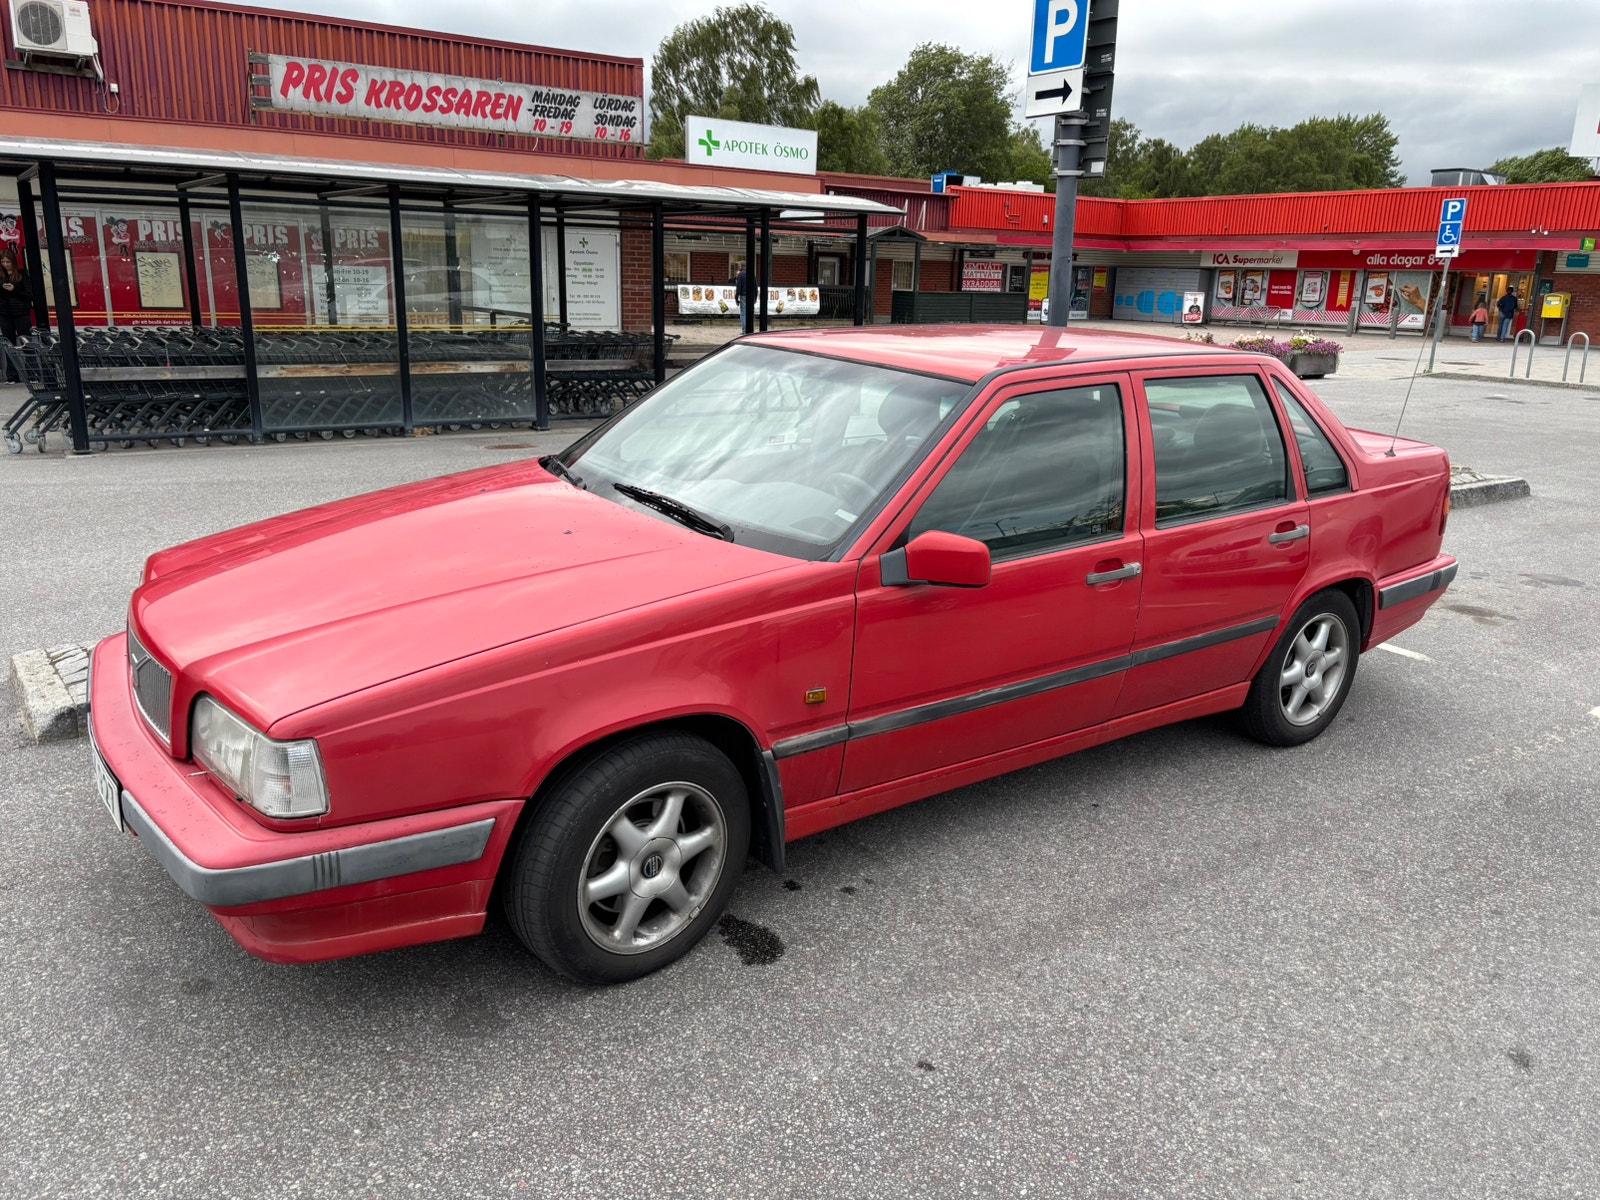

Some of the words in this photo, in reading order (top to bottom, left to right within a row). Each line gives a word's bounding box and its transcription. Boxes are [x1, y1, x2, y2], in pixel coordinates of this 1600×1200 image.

[1044, 0, 1078, 64] P
[280, 61, 359, 105] PRIS
[364, 78, 523, 123] KROSSAREN
[531, 89, 581, 108] MÅNDAG
[593, 94, 636, 113] LÖRDAG
[527, 105, 576, 121] -FREDAG
[593, 111, 637, 128] SÖNDAG
[533, 119, 547, 132] 10
[559, 121, 573, 134] 19
[594, 127, 608, 140] 10
[619, 129, 632, 142] 16
[723, 140, 768, 156] APOTEK
[773, 142, 809, 160] ÖSMO
[1446, 201, 1461, 220] P
[334, 228, 379, 249] PRIS
[963, 262, 1003, 271] KEMTVÄTT
[1212, 253, 1230, 265] ICA
[1232, 254, 1284, 266] Supermarket
[1366, 253, 1387, 265] alla
[1389, 253, 1425, 268] dagar
[1427, 253, 1446, 266] 8-2
[962, 270, 1002, 279] MATTVÄTT
